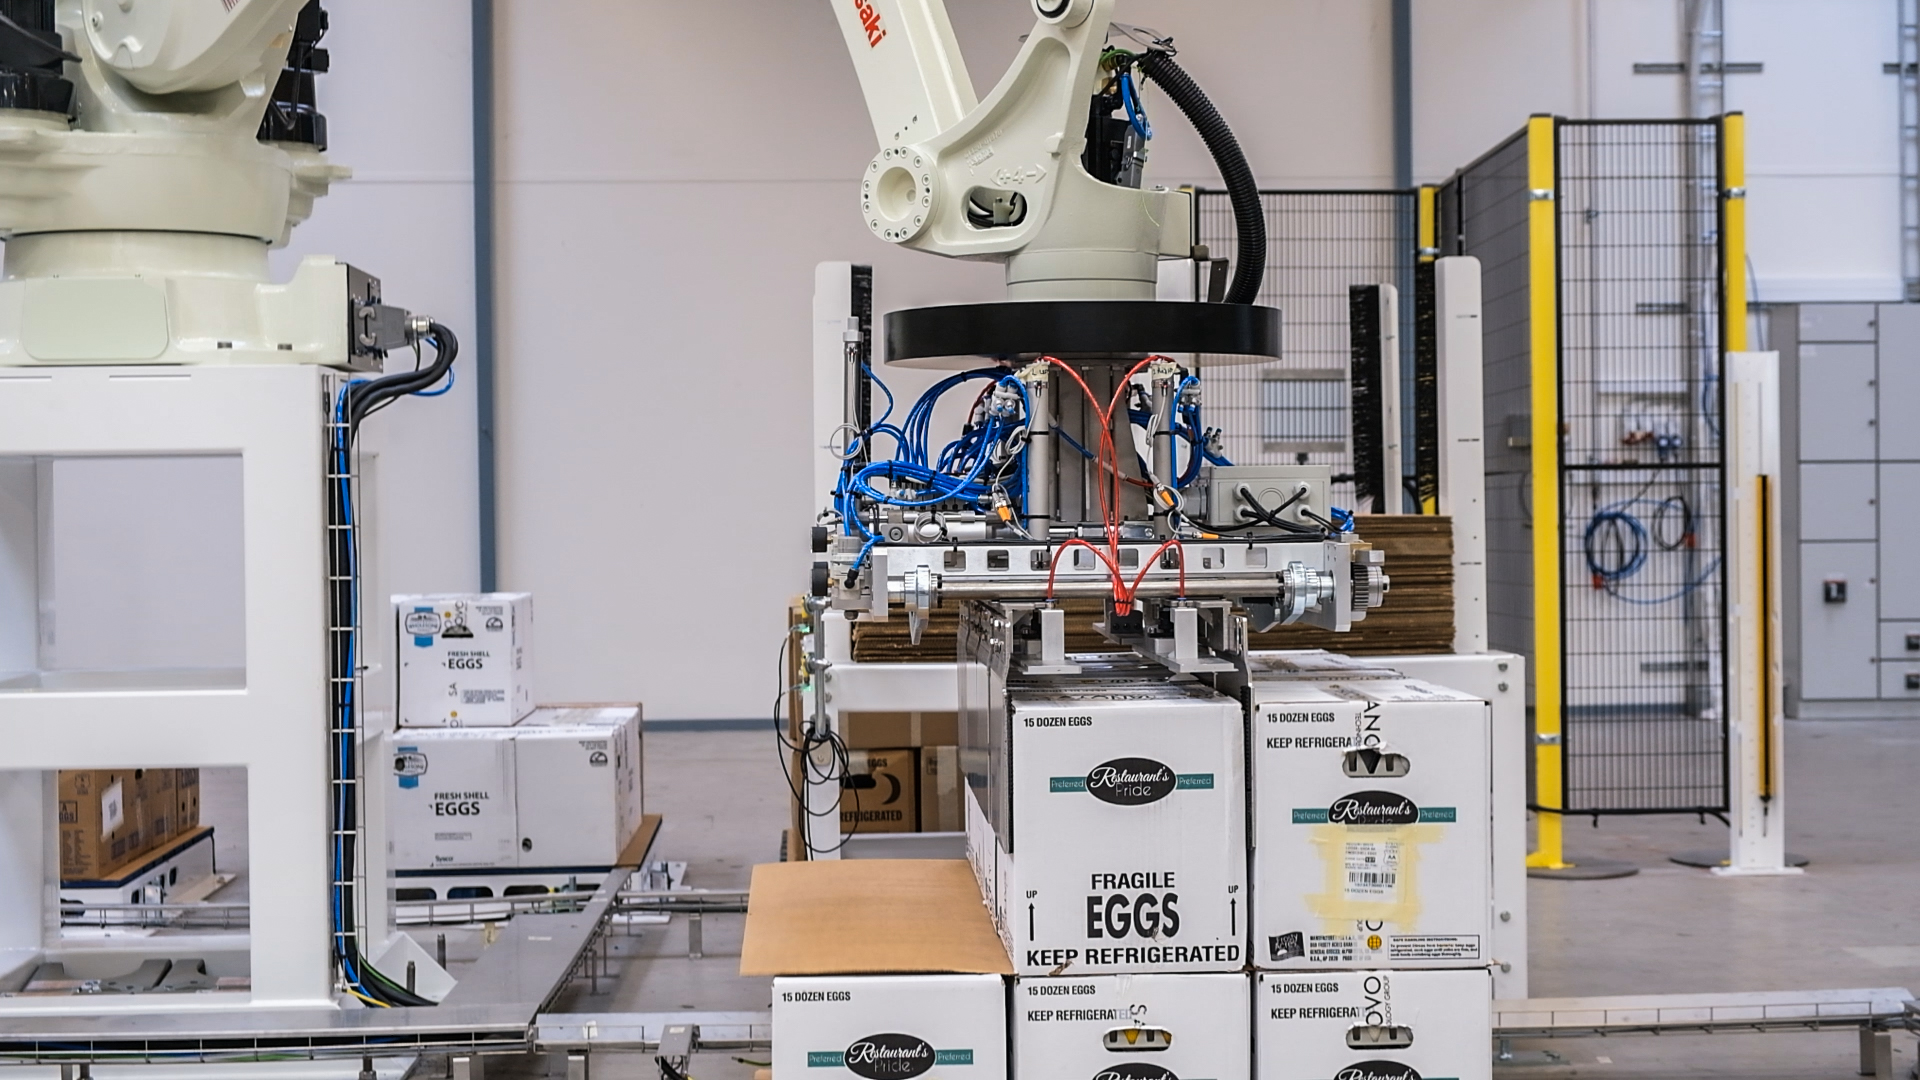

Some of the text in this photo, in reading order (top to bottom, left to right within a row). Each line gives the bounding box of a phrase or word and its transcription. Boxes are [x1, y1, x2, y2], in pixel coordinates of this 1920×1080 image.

[448, 658, 483, 669] EGGS
[1023, 716, 1093, 727] 15 DOZEN EGGS
[1267, 712, 1335, 723] 15 DOZEN EGGS
[1266, 737, 1293, 748] KEEP
[1090, 766, 1169, 788] Restaurant's
[1179, 777, 1212, 787] Preferred
[1051, 780, 1084, 789] Preferred
[1115, 783, 1152, 797] Pride
[434, 791, 490, 800] FRESH SHELL
[435, 801, 481, 816] EGGS
[1333, 799, 1412, 820] Restaurant's
[1421, 809, 1454, 819] Preferred
[1293, 811, 1326, 821] Preferred
[1091, 872, 1175, 890] FRAGILE
[1026, 890, 1038, 899] UP
[1228, 885, 1239, 894] UP
[1086, 892, 1180, 939] EGGS
[1027, 945, 1240, 966] KEEP REFRIGERATED
[1028, 985, 1096, 996] 15 DOZEN EGGS
[1271, 983, 1339, 993] 15 DOZEN EGGS
[782, 991, 851, 1002] 15 DOZEN EGGS
[1028, 1010, 1053, 1021] KEEP
[1271, 1008, 1297, 1019] KEEP
[849, 1041, 928, 1064] Restaurant's
[938, 1052, 971, 1062] Preferred
[809, 1054, 842, 1064] Preferred
[874, 1059, 909, 1073] Pride
